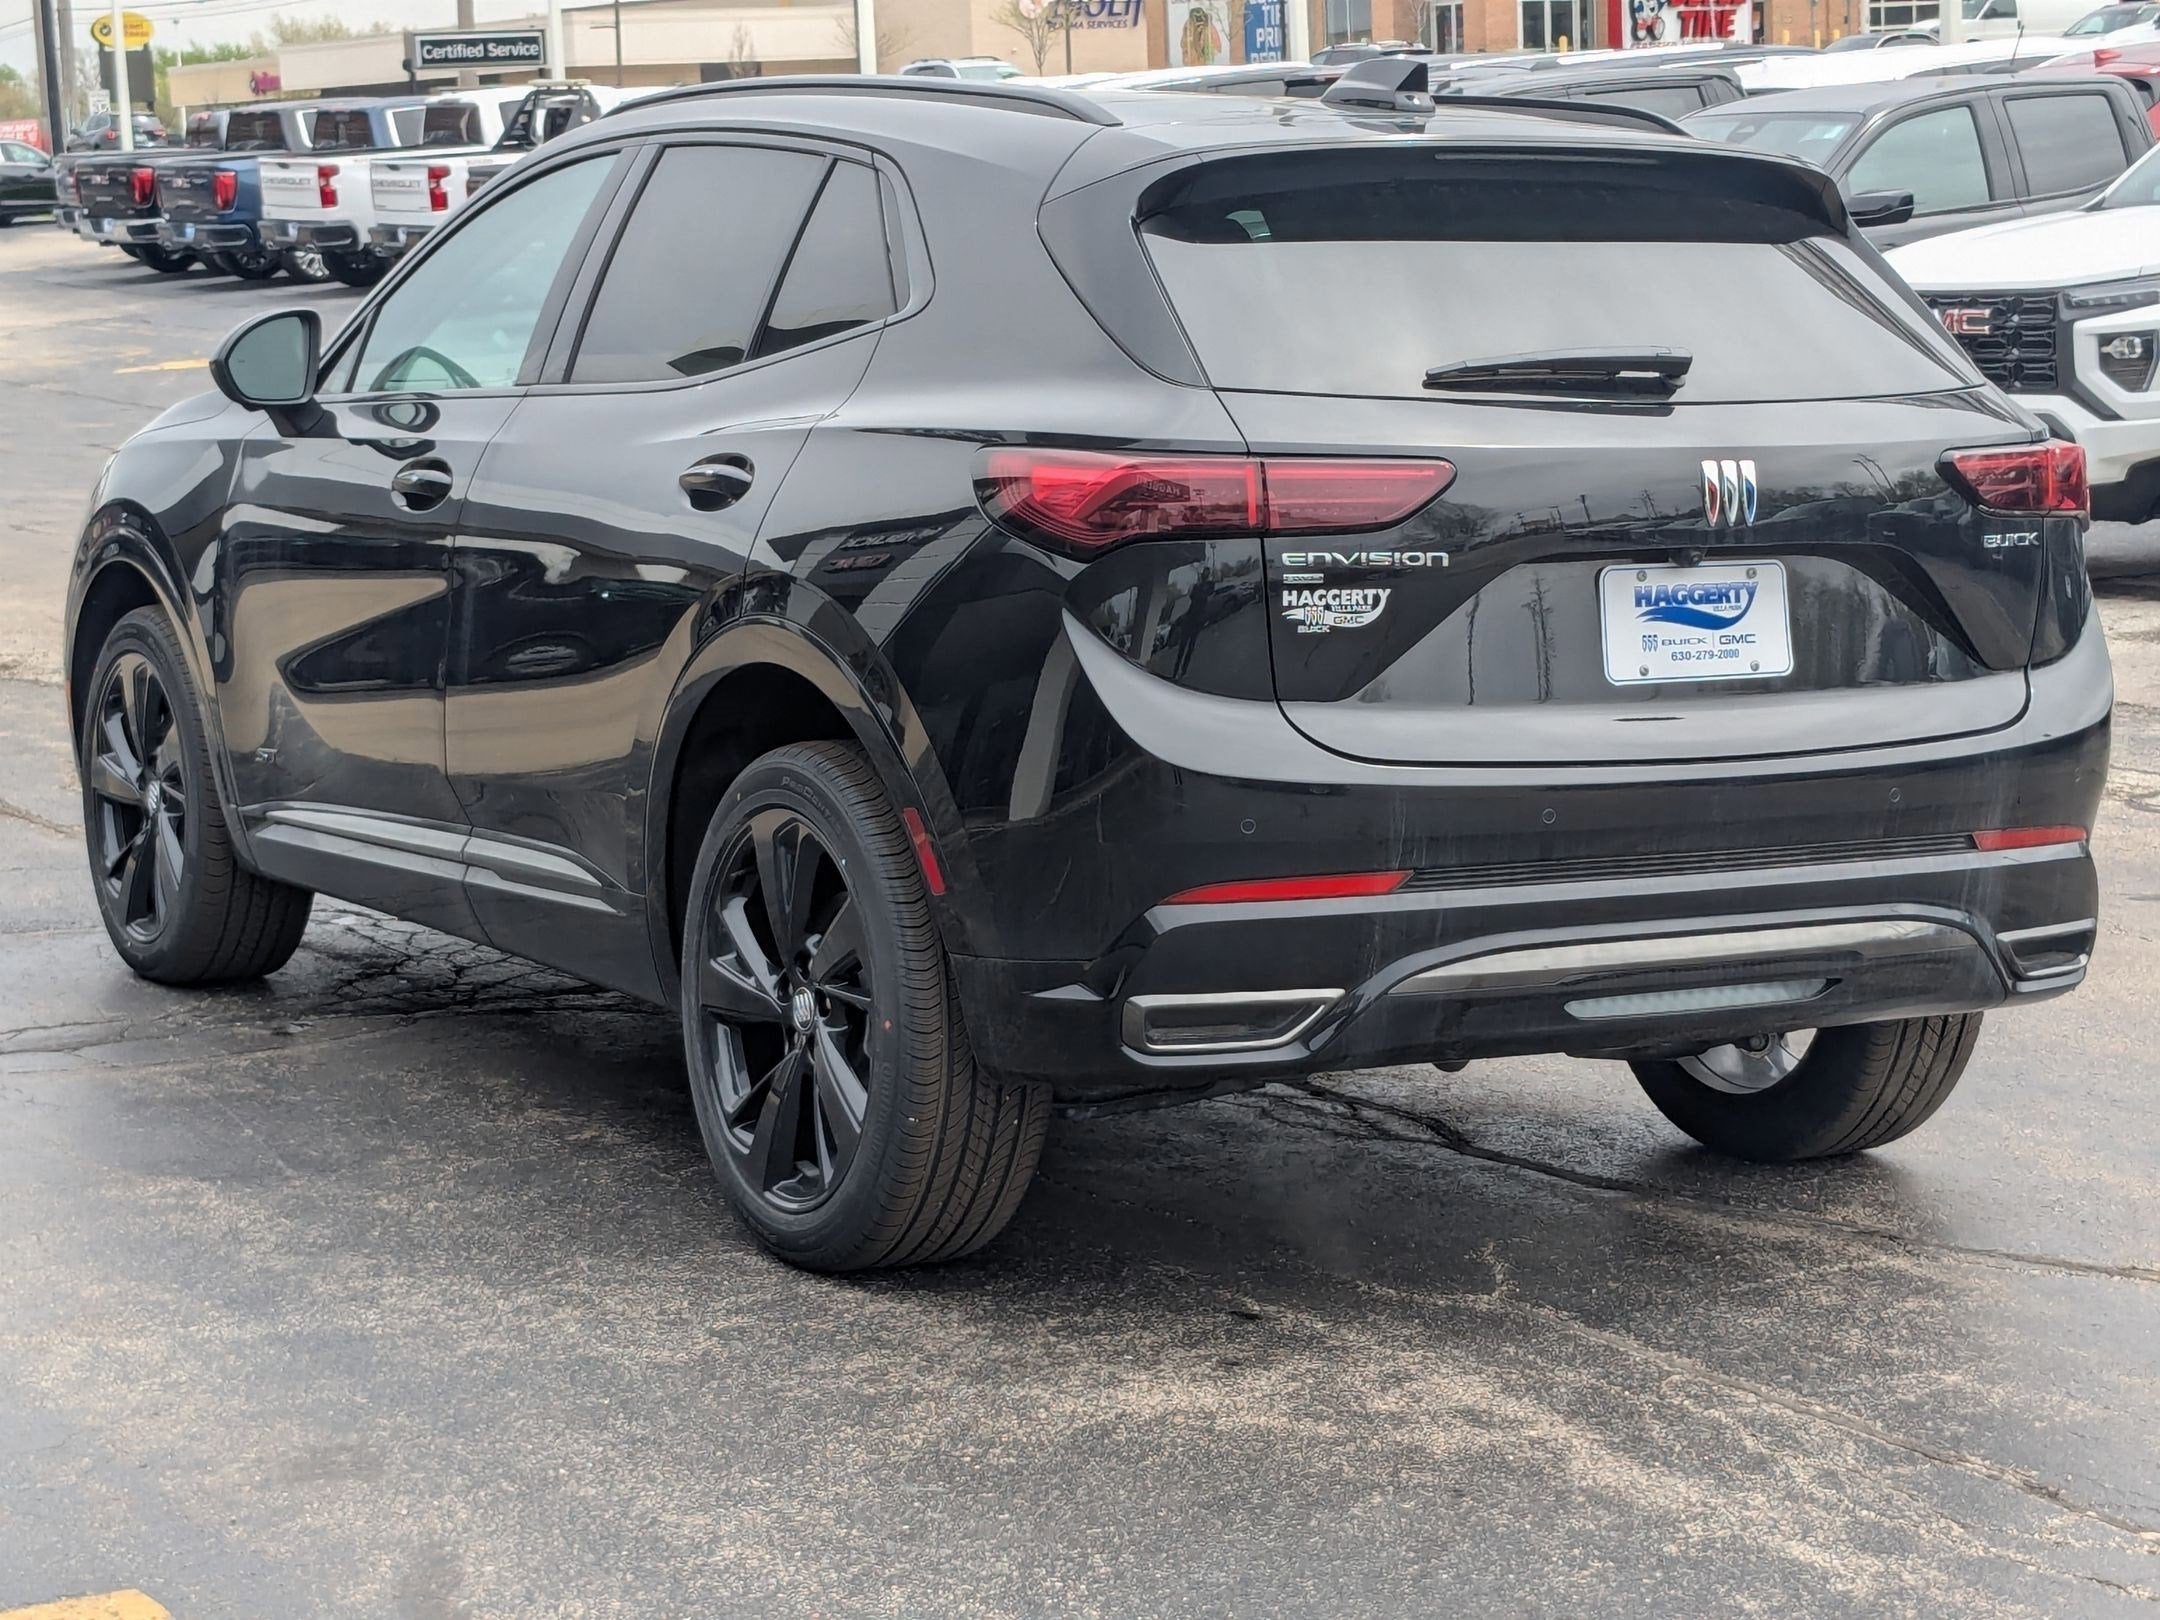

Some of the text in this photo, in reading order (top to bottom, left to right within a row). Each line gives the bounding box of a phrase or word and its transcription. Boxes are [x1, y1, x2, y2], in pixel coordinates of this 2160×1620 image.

[1087, 20, 1127, 29] SERVICES
[423, 42, 539, 59] Certified Service
[1983, 532, 2040, 548] BUICK
[1281, 552, 1450, 567] ENVISION
[1282, 588, 1392, 607] HAGGERTY
[1634, 581, 1759, 608] HAGGERTY
[1333, 615, 1365, 624] GMC
[1297, 625, 1331, 633] BUICK
[1661, 633, 1756, 646] BUICK GMC
[1671, 648, 1740, 661] 630-279-2000
